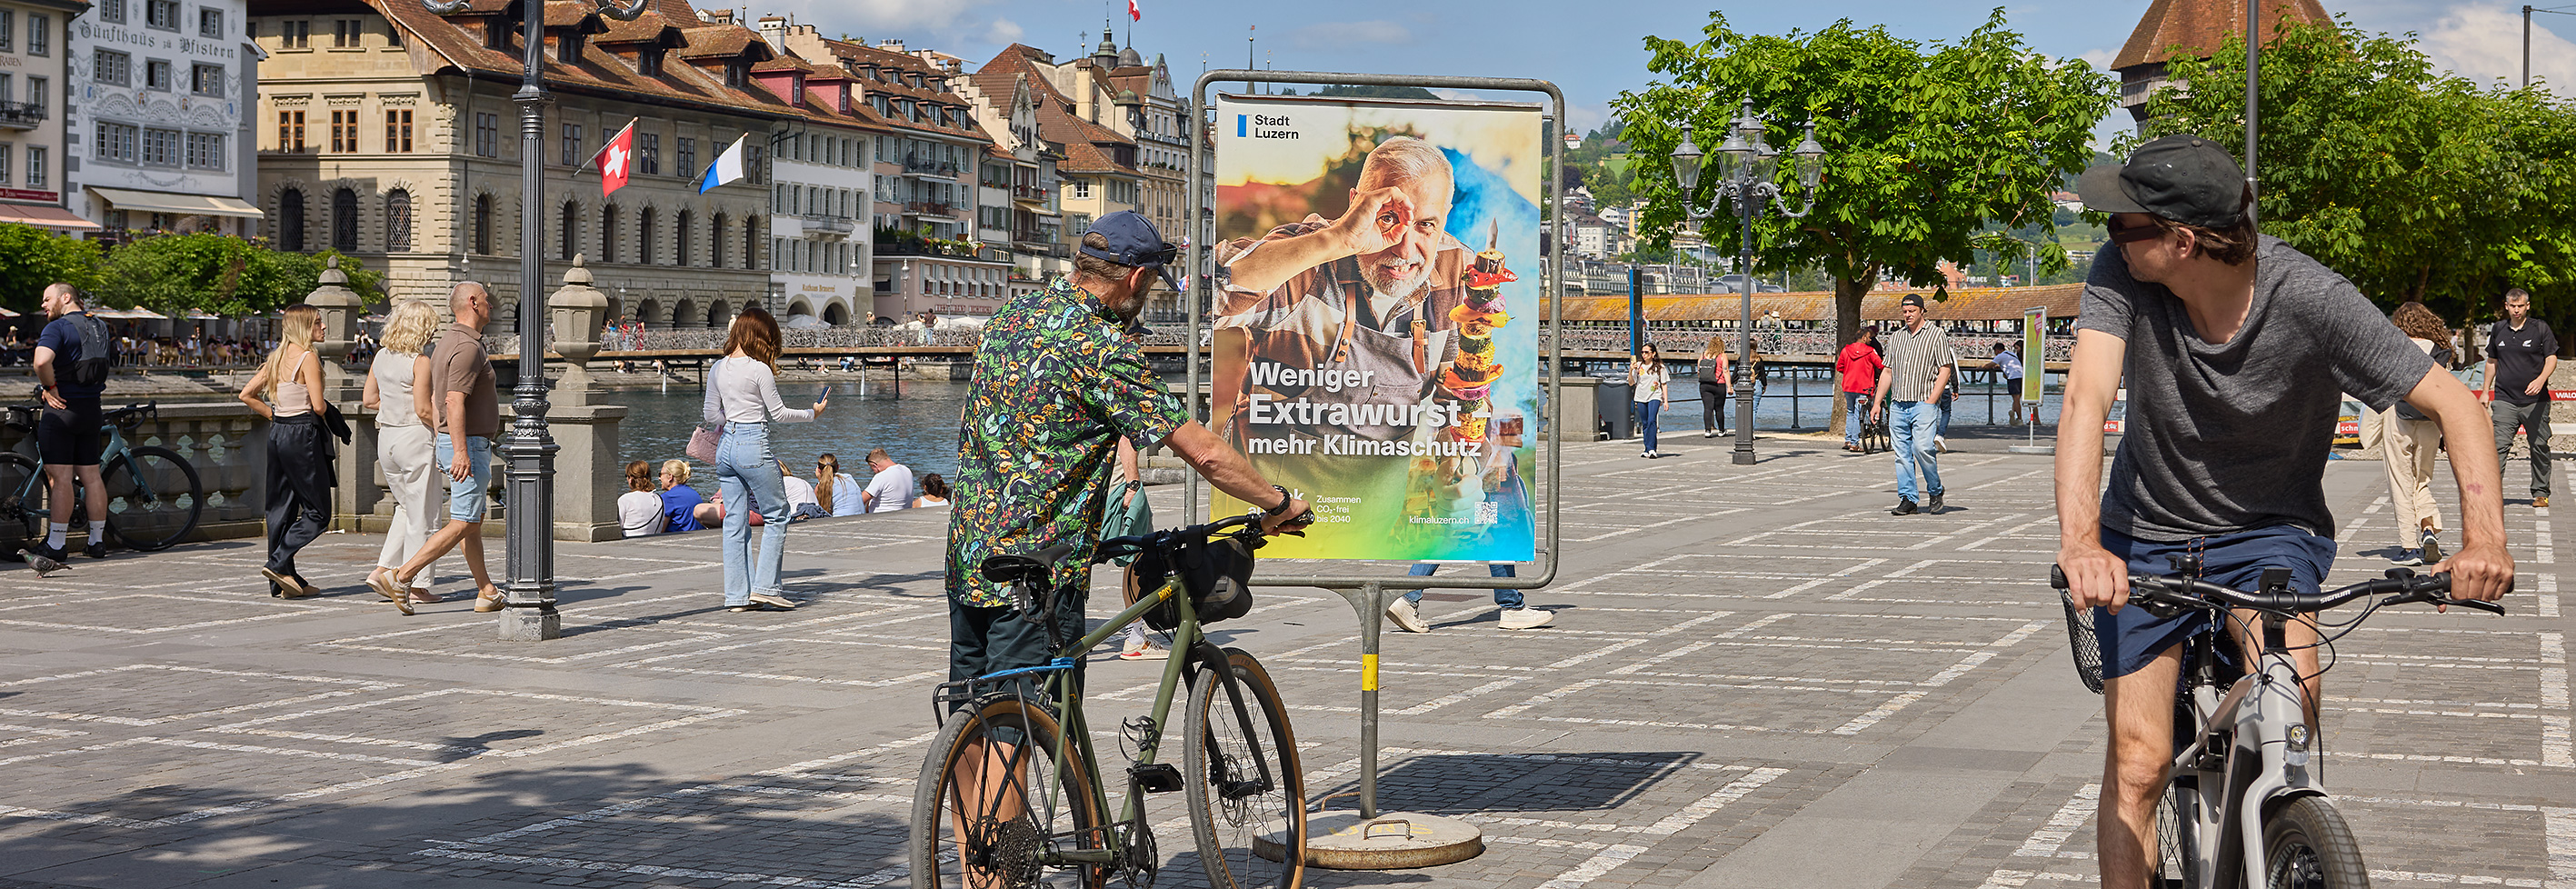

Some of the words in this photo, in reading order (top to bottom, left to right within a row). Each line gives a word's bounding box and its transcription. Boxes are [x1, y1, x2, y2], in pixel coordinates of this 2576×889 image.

[1254, 114, 1290, 126] Stadt
[1254, 127, 1299, 139] Luzern
[1249, 362, 1374, 392] Weniger
[1249, 394, 1462, 427] Extrawurst
[1248, 435, 1316, 454] mehr
[1323, 434, 1482, 456] Klimaschutz
[1316, 495, 1362, 504] Zusammen
[1409, 516, 1470, 524] klimaluzern.ch
